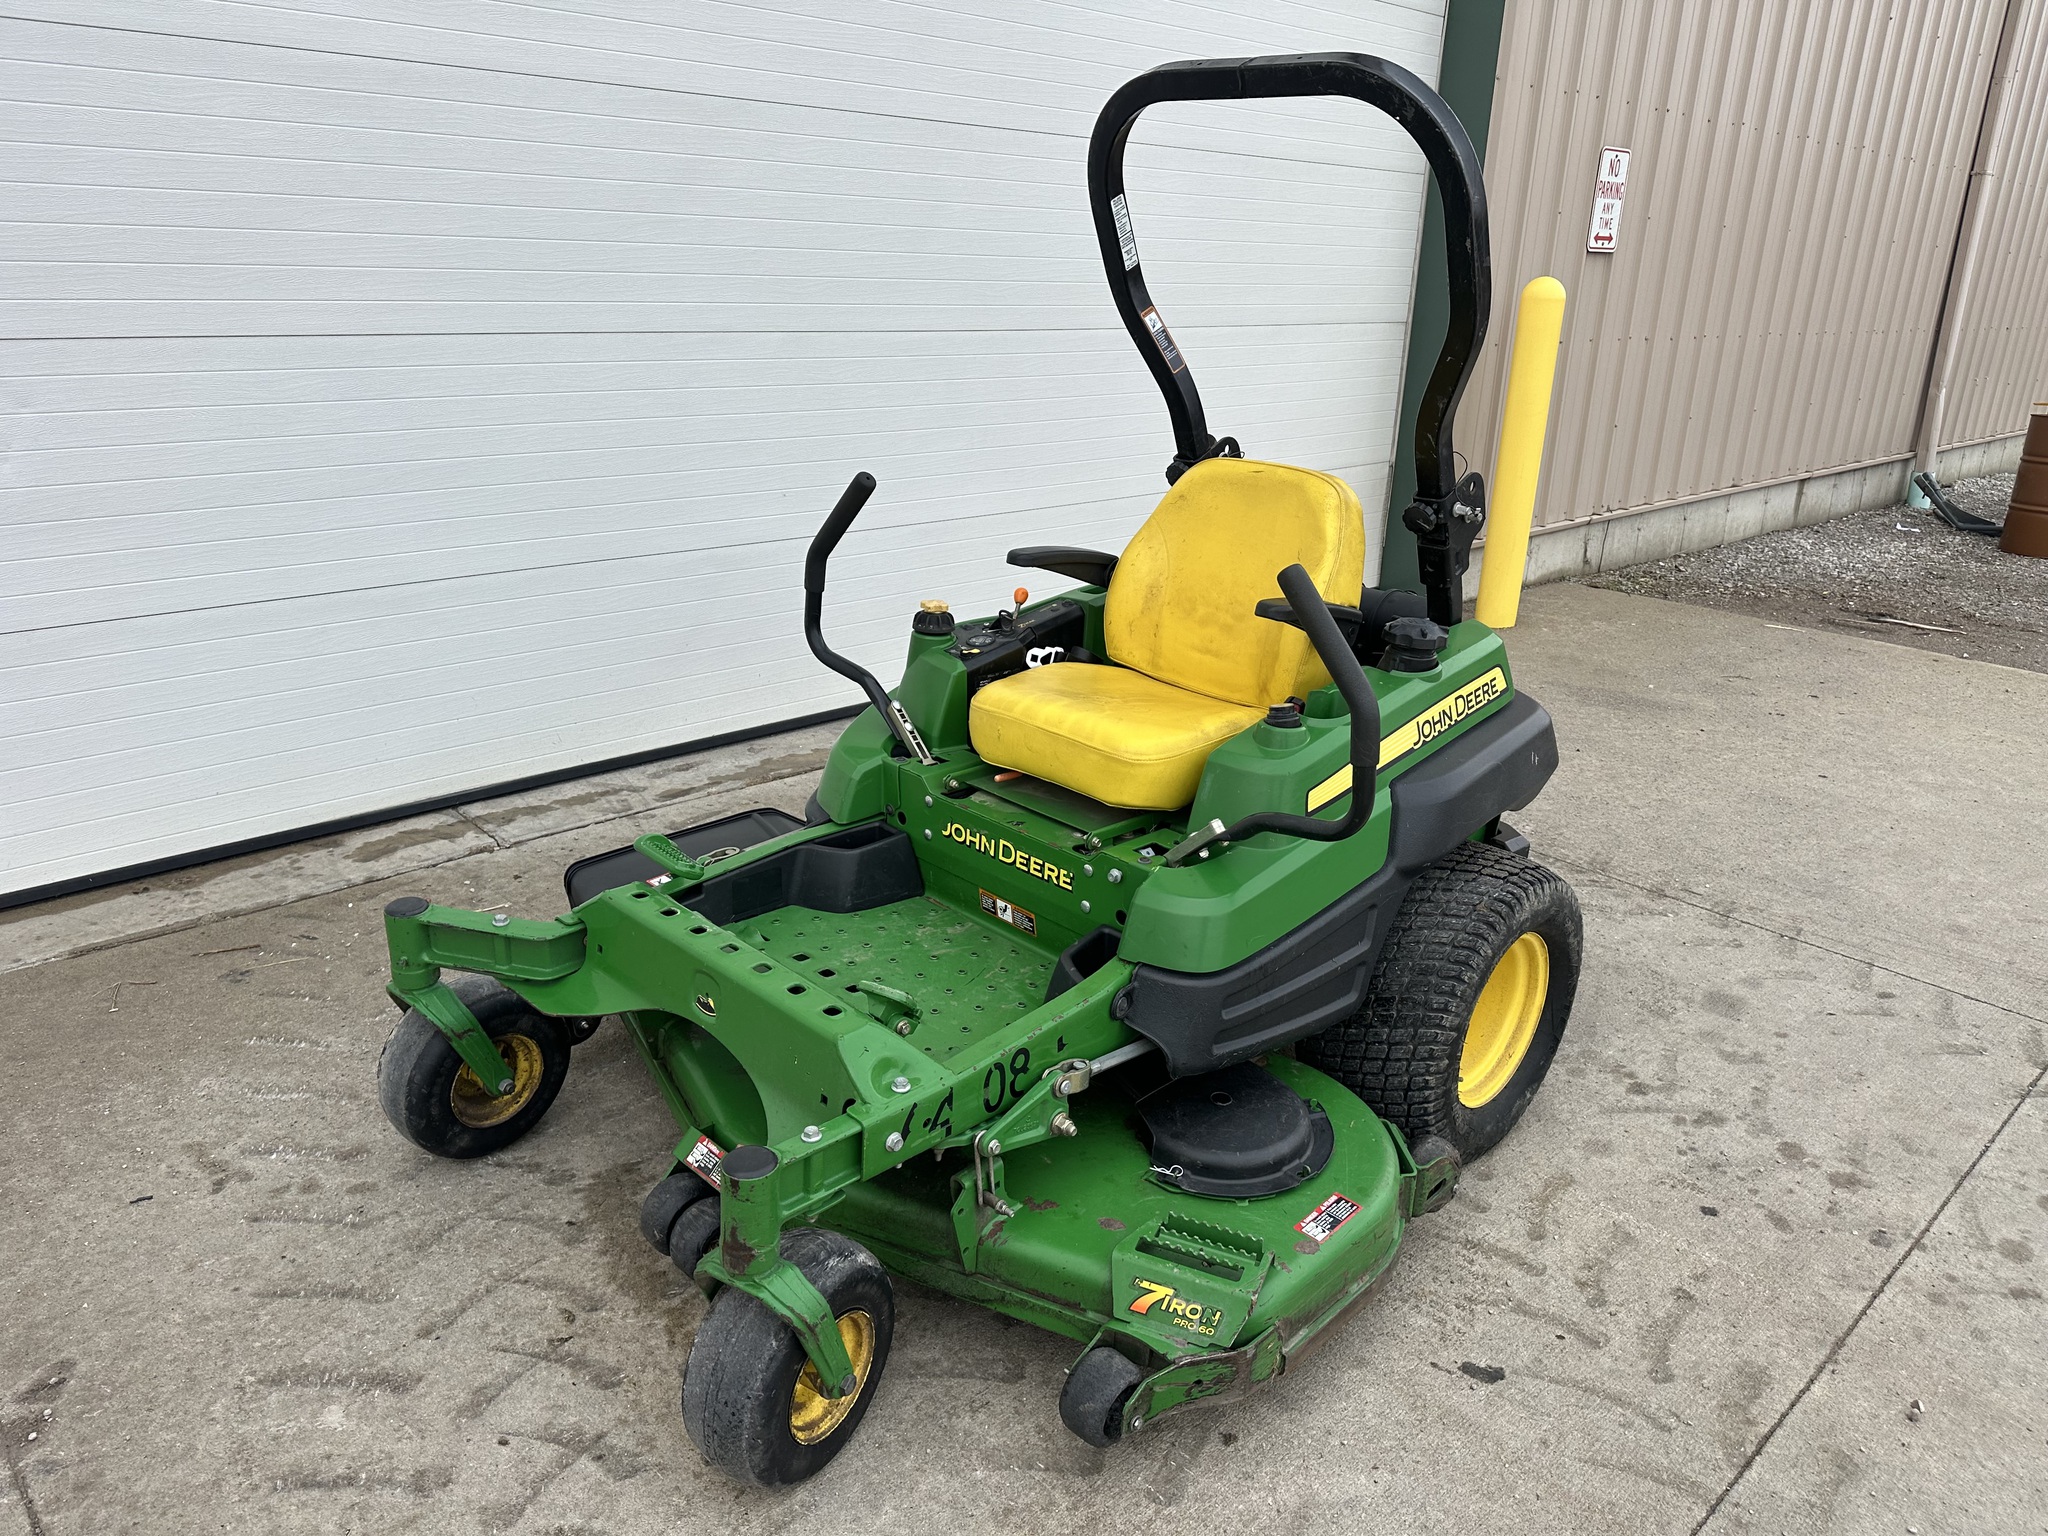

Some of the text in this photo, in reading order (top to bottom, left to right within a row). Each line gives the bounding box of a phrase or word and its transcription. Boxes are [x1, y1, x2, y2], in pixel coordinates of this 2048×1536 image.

[1608, 158, 1621, 177] NO
[1598, 180, 1625, 200] PARKING
[1601, 202, 1615, 215] ANY
[1599, 217, 1614, 230] TIME
[1413, 677, 1499, 746] JOHN DEERE
[941, 822, 1074, 891] JOHN DEERE
[1172, 1317, 1215, 1336] PRO 60
